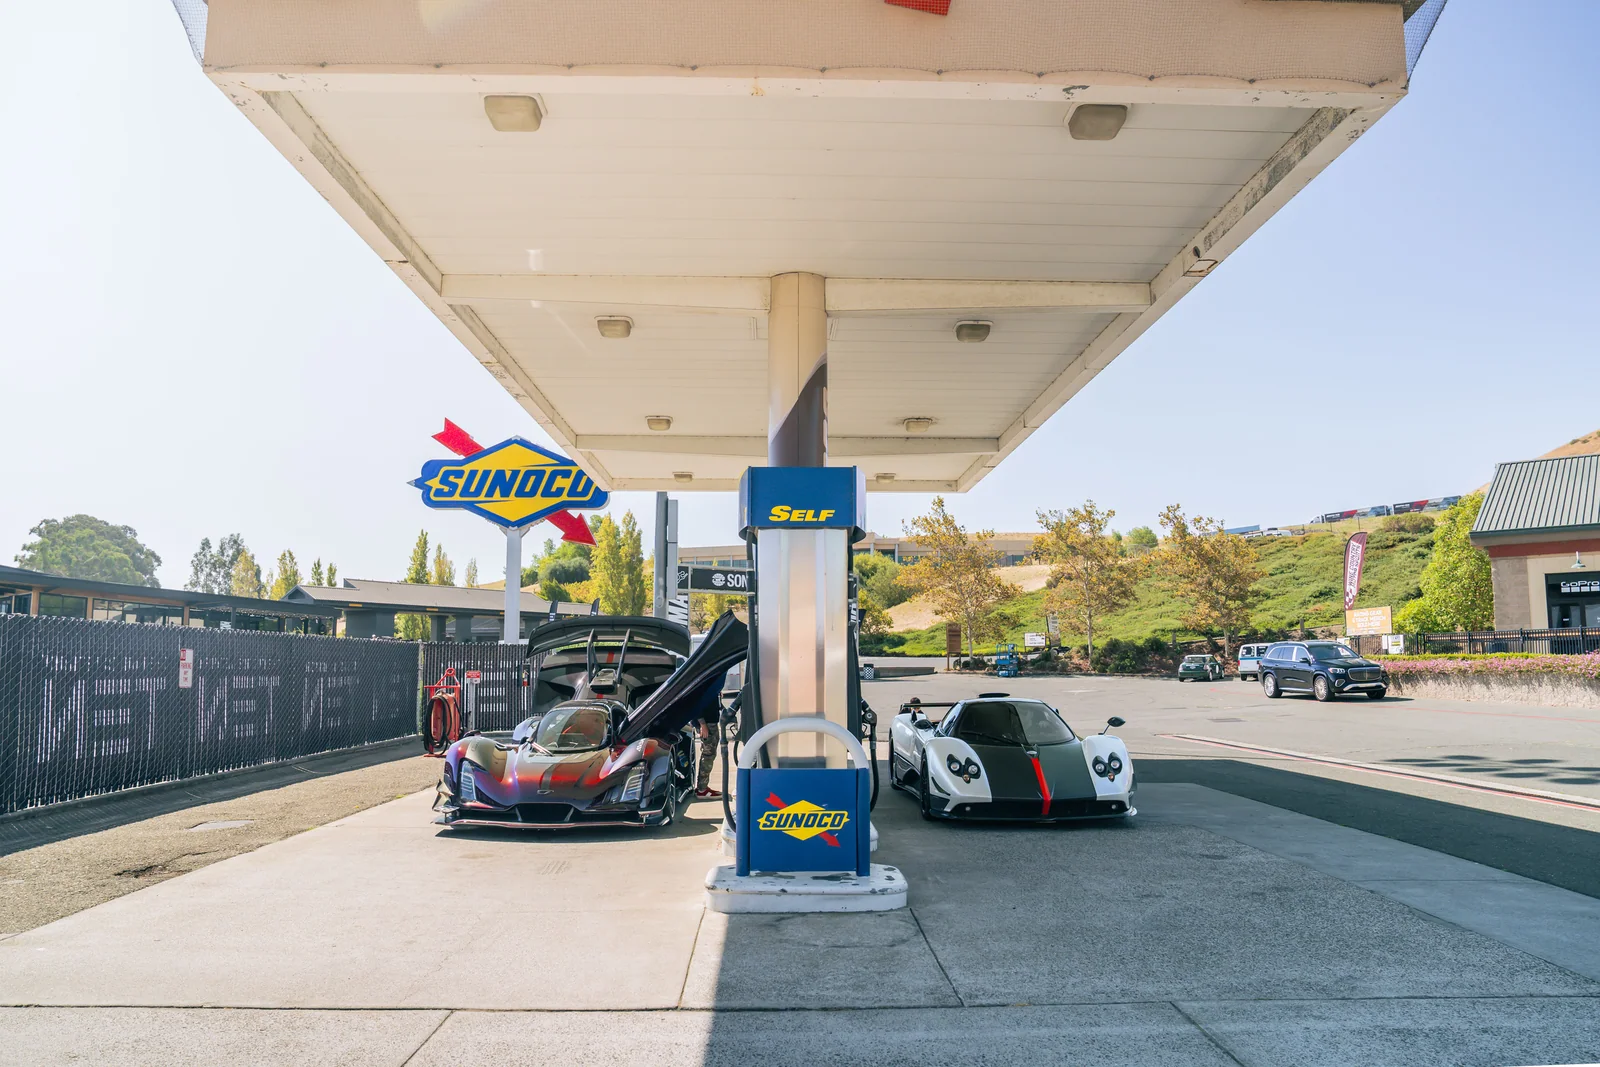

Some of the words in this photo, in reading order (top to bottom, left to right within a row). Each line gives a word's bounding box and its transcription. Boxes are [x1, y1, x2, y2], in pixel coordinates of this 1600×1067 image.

[433, 469, 595, 499] SUNOCO
[768, 505, 836, 522] SELF
[727, 573, 748, 588] SON
[762, 813, 845, 828] SUNOCO
